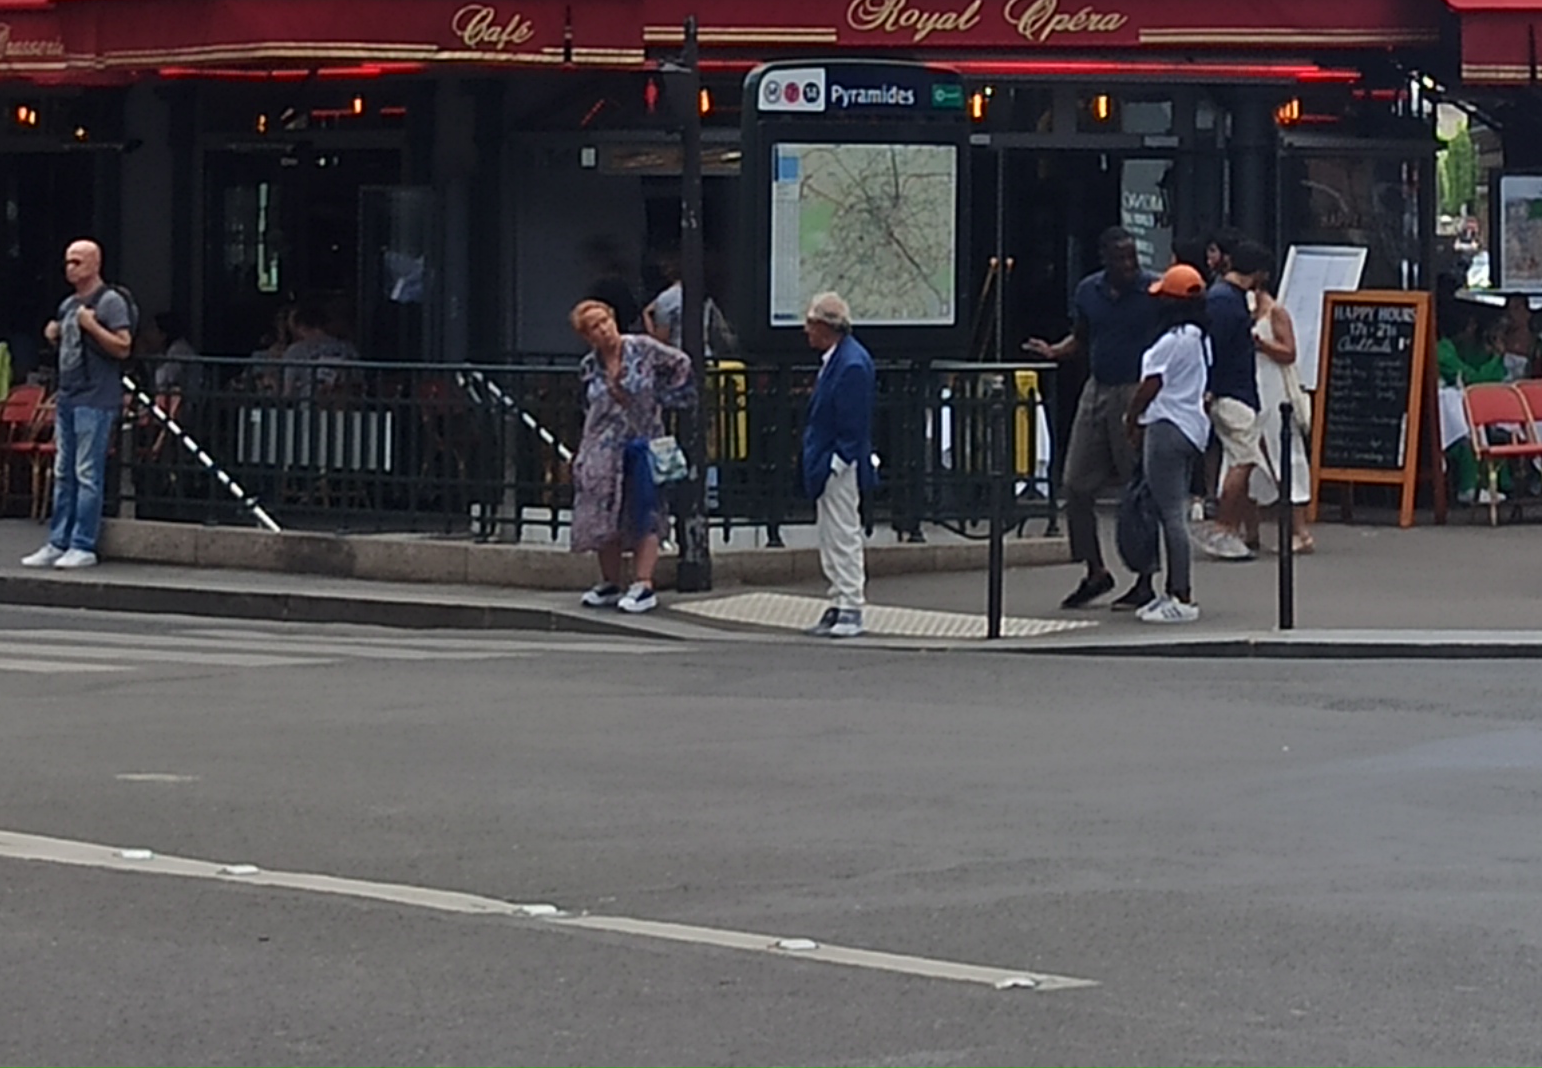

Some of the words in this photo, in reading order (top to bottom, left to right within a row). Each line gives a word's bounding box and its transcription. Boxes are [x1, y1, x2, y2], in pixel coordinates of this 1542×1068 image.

[452, 4, 535, 50] Café
[831, 84, 915, 107] Pyramides
[1335, 306, 1375, 321] HAPPY
[1379, 308, 1416, 322] HOURS
